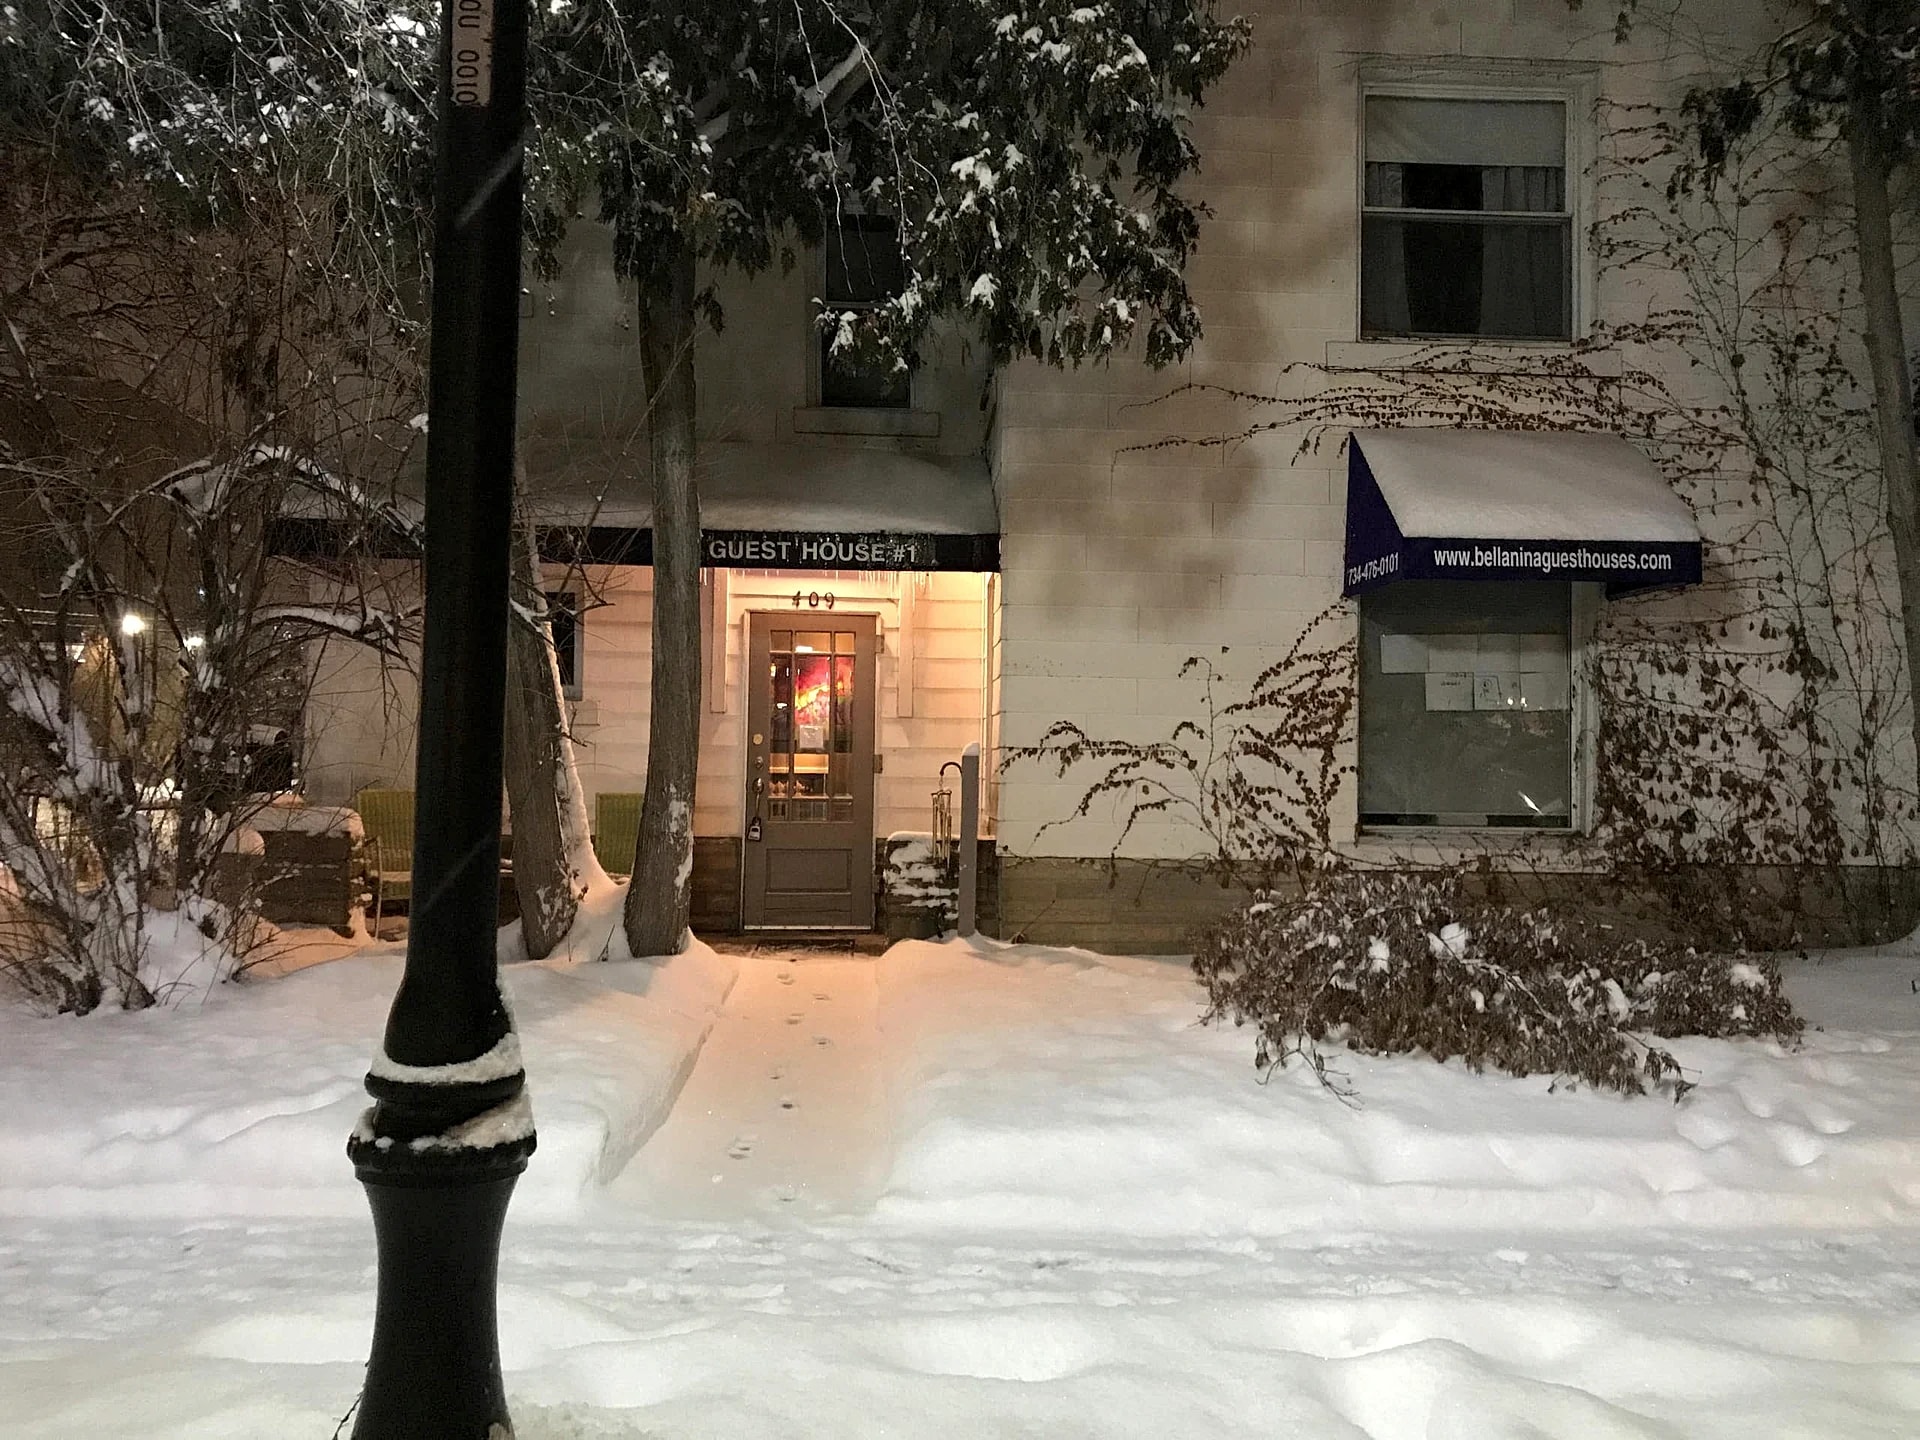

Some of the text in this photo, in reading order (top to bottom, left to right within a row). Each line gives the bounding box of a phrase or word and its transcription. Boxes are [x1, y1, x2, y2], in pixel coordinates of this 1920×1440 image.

[709, 541, 792, 560] GUEST
[802, 542, 886, 563] HOUSE
[1434, 546, 1672, 573] www.bellaninaguesthouses.com
[1348, 551, 1399, 587] 734-476-0101
[792, 590, 835, 610] 409
